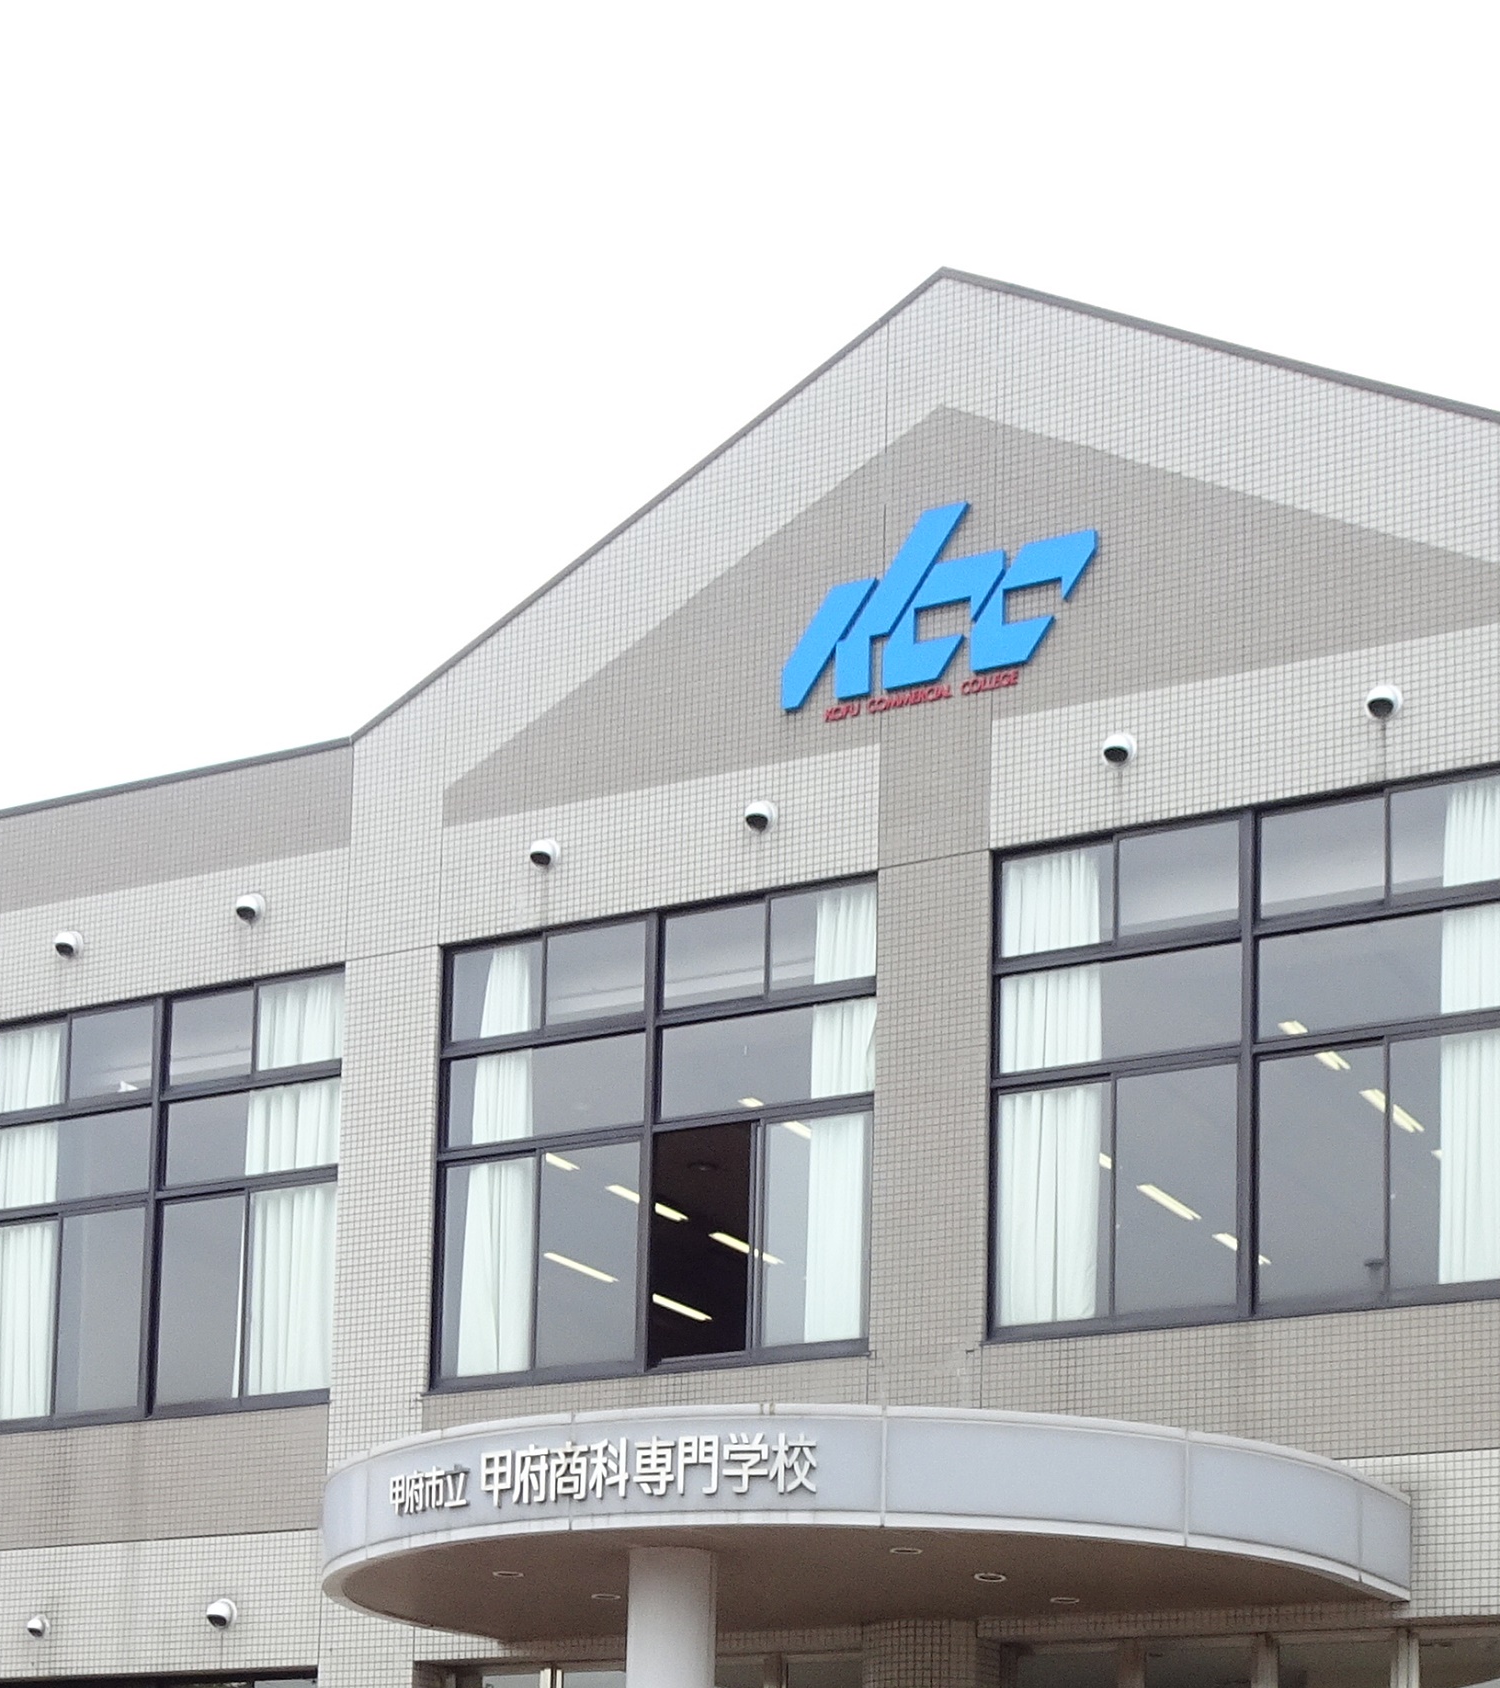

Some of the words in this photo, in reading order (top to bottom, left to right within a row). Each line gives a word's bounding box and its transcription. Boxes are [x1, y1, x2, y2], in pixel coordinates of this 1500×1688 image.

[823, 703, 861, 723] KOFU
[867, 684, 953, 715] COMMERCIAL
[960, 670, 1020, 696] COLLEGE
[388, 1463, 470, 1516] 甲府市立
[479, 1431, 818, 1508] 甲府商科専門学校
